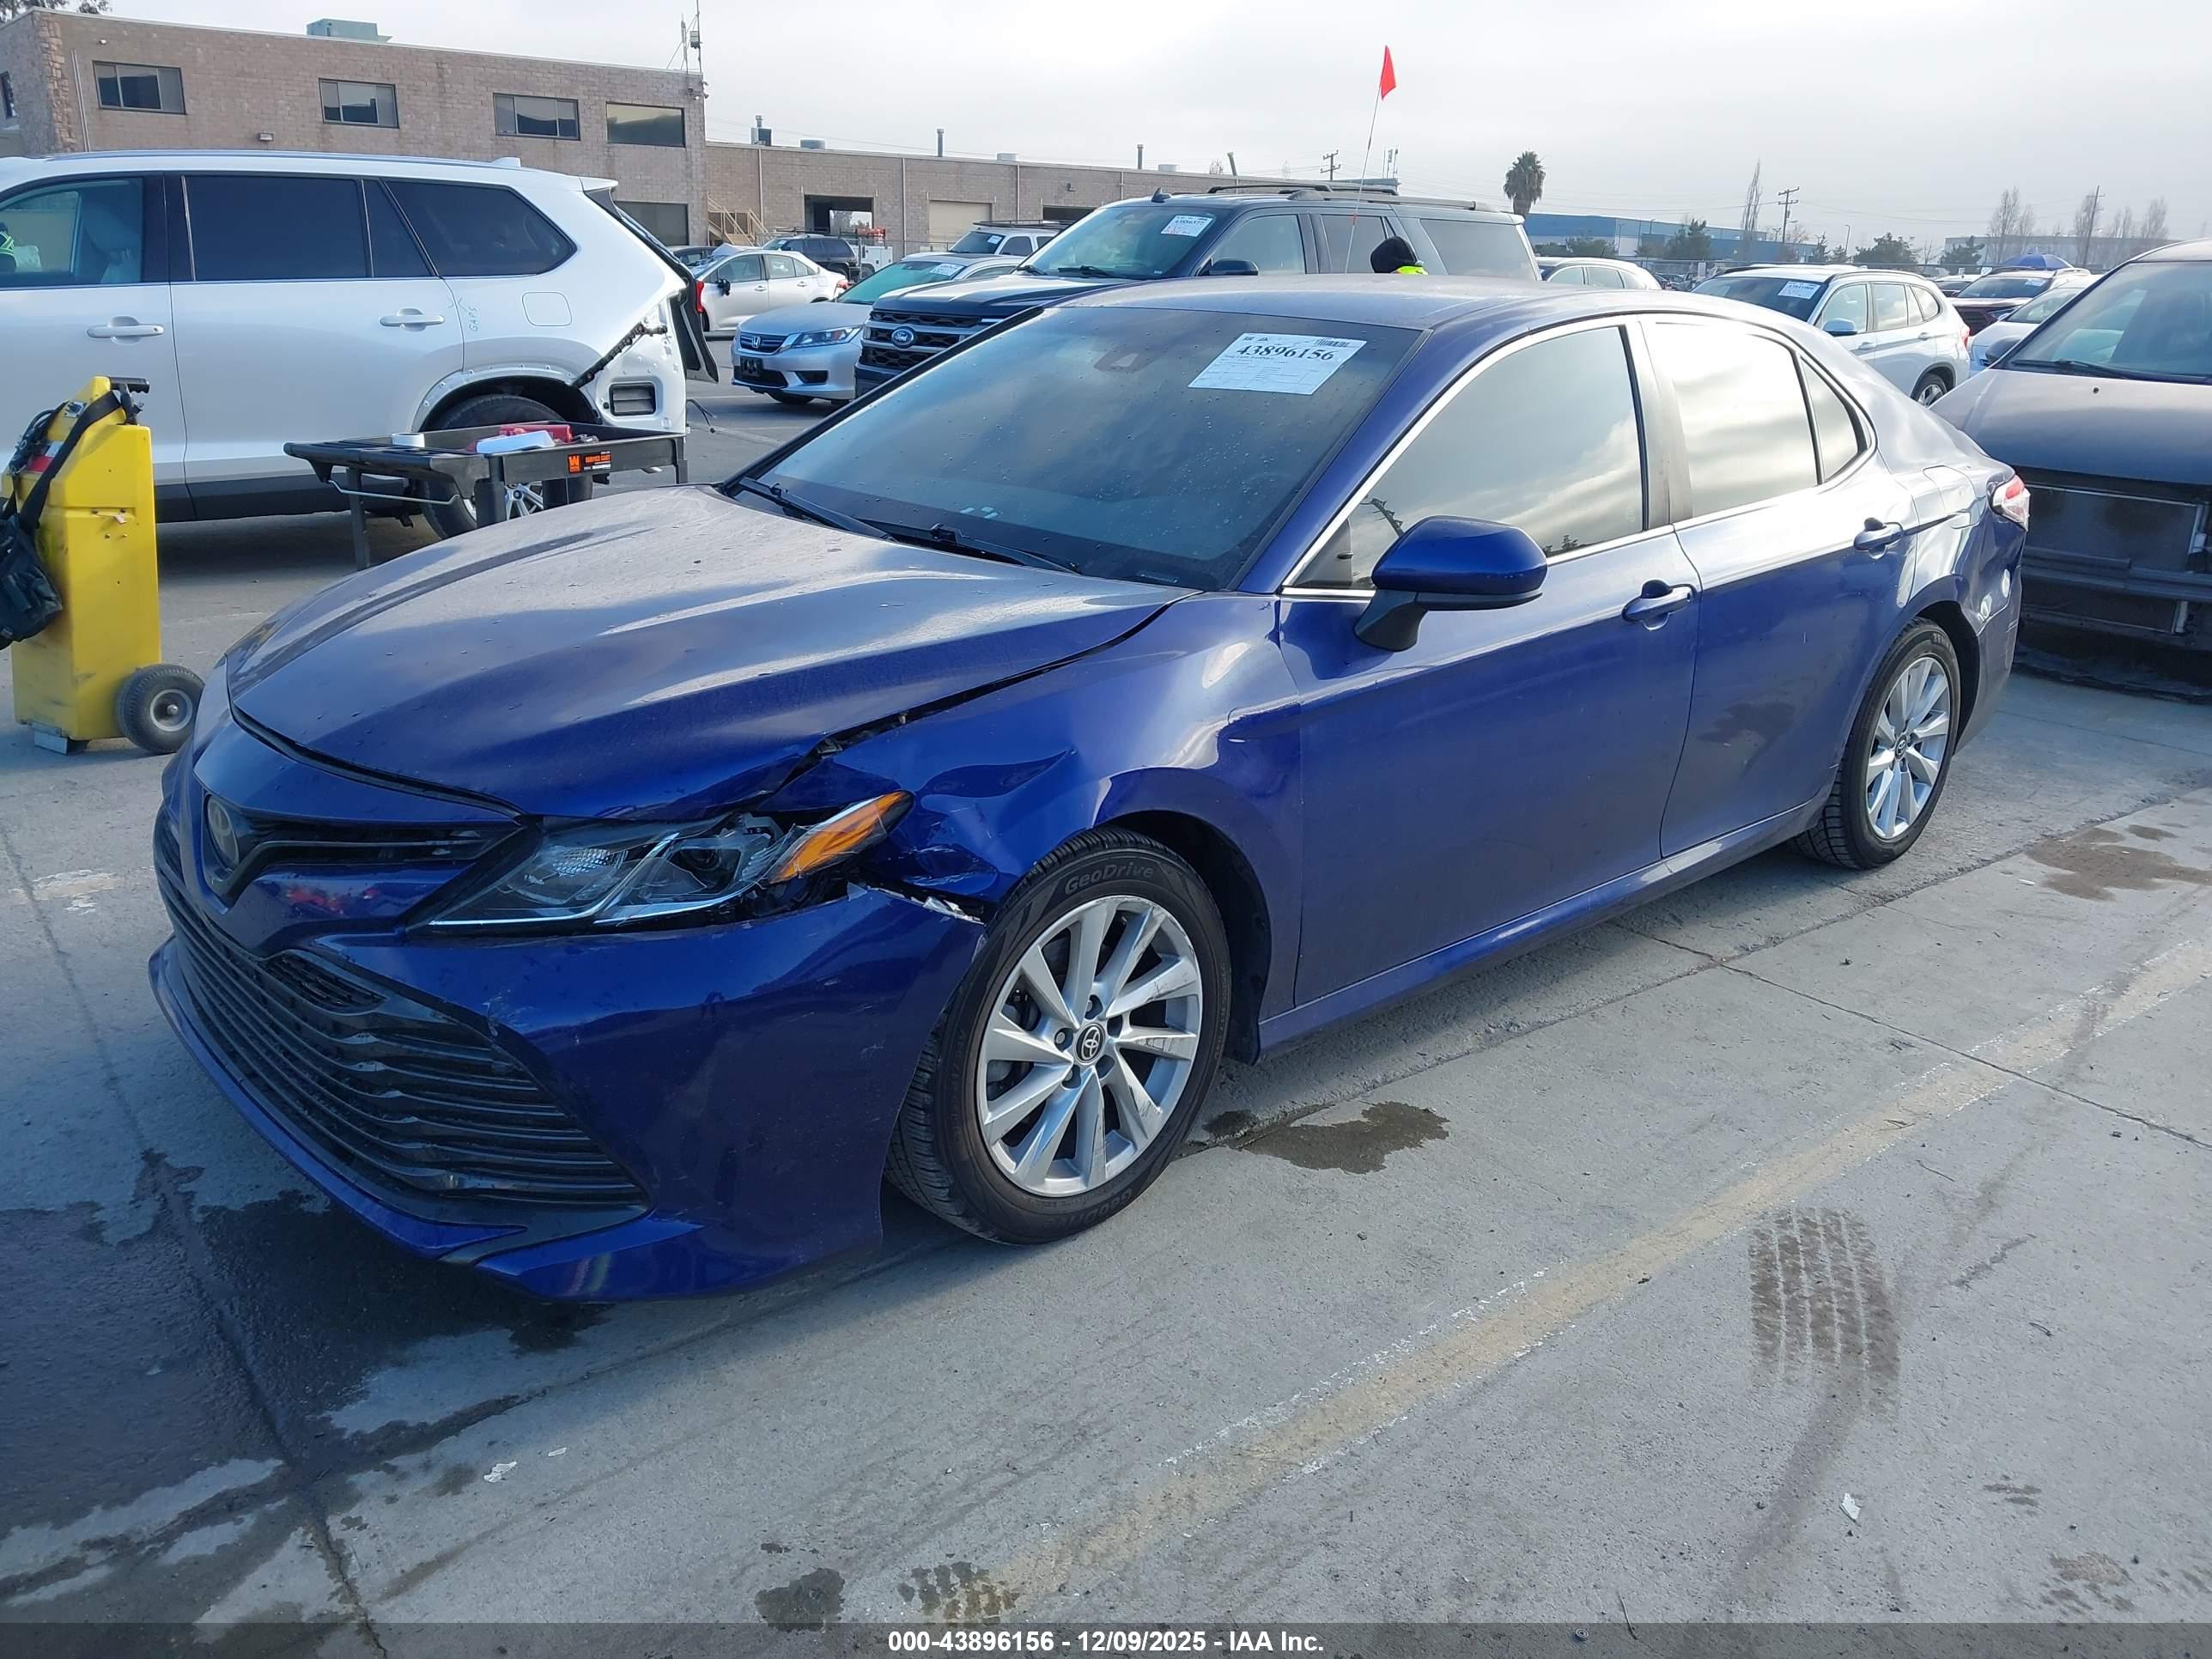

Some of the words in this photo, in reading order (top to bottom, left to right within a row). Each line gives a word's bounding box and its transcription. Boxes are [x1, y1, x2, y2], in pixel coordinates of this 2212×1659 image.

[468, 306, 479, 332] GAPS
[1237, 344, 1336, 361] 43896156
[1065, 861, 1153, 896] GeoDrive
